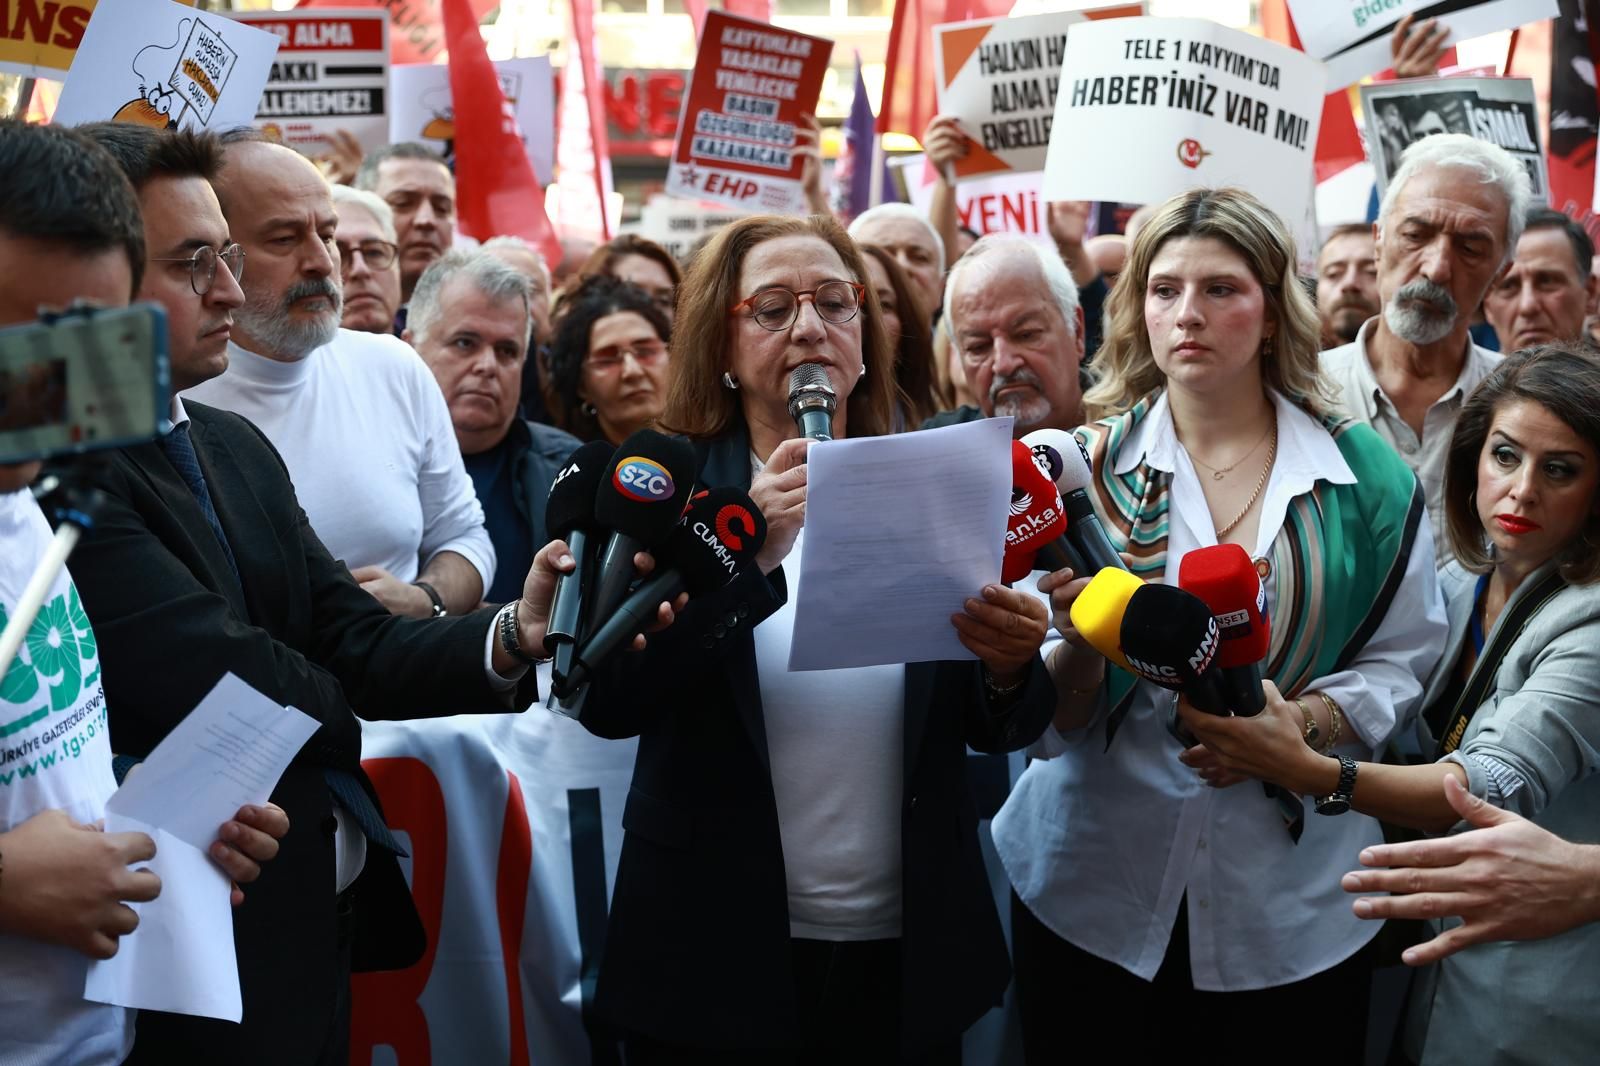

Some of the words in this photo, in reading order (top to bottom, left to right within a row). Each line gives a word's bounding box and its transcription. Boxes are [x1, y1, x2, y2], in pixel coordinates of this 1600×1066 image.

[294, 22, 354, 46] ALMA
[978, 38, 1042, 76] HALKIN
[1045, 34, 1067, 68] HA
[1124, 39, 1166, 59] TELE
[1174, 40, 1182, 60] 1
[1188, 41, 1281, 91] KAYYIM'DA
[268, 62, 317, 82] AKKI
[259, 89, 372, 115] LLENEMEZ!
[991, 78, 1044, 114] ALMA
[1071, 70, 1218, 117] HABER'İNİZ
[1225, 90, 1269, 135] VAR
[1274, 108, 1309, 151] MI!
[980, 116, 1053, 151] ENGELLE
[695, 138, 789, 165] KAZANACAK
[702, 172, 759, 200] EHP
[957, 191, 1040, 235] YENİ
[621, 464, 667, 495] SZC
[1006, 508, 1056, 542] anka
[1216, 612, 1245, 626] NŞET
[1188, 616, 1217, 670] NNC
[1125, 653, 1177, 677] NNC
[0, 737, 40, 766] ÜRKİYE
